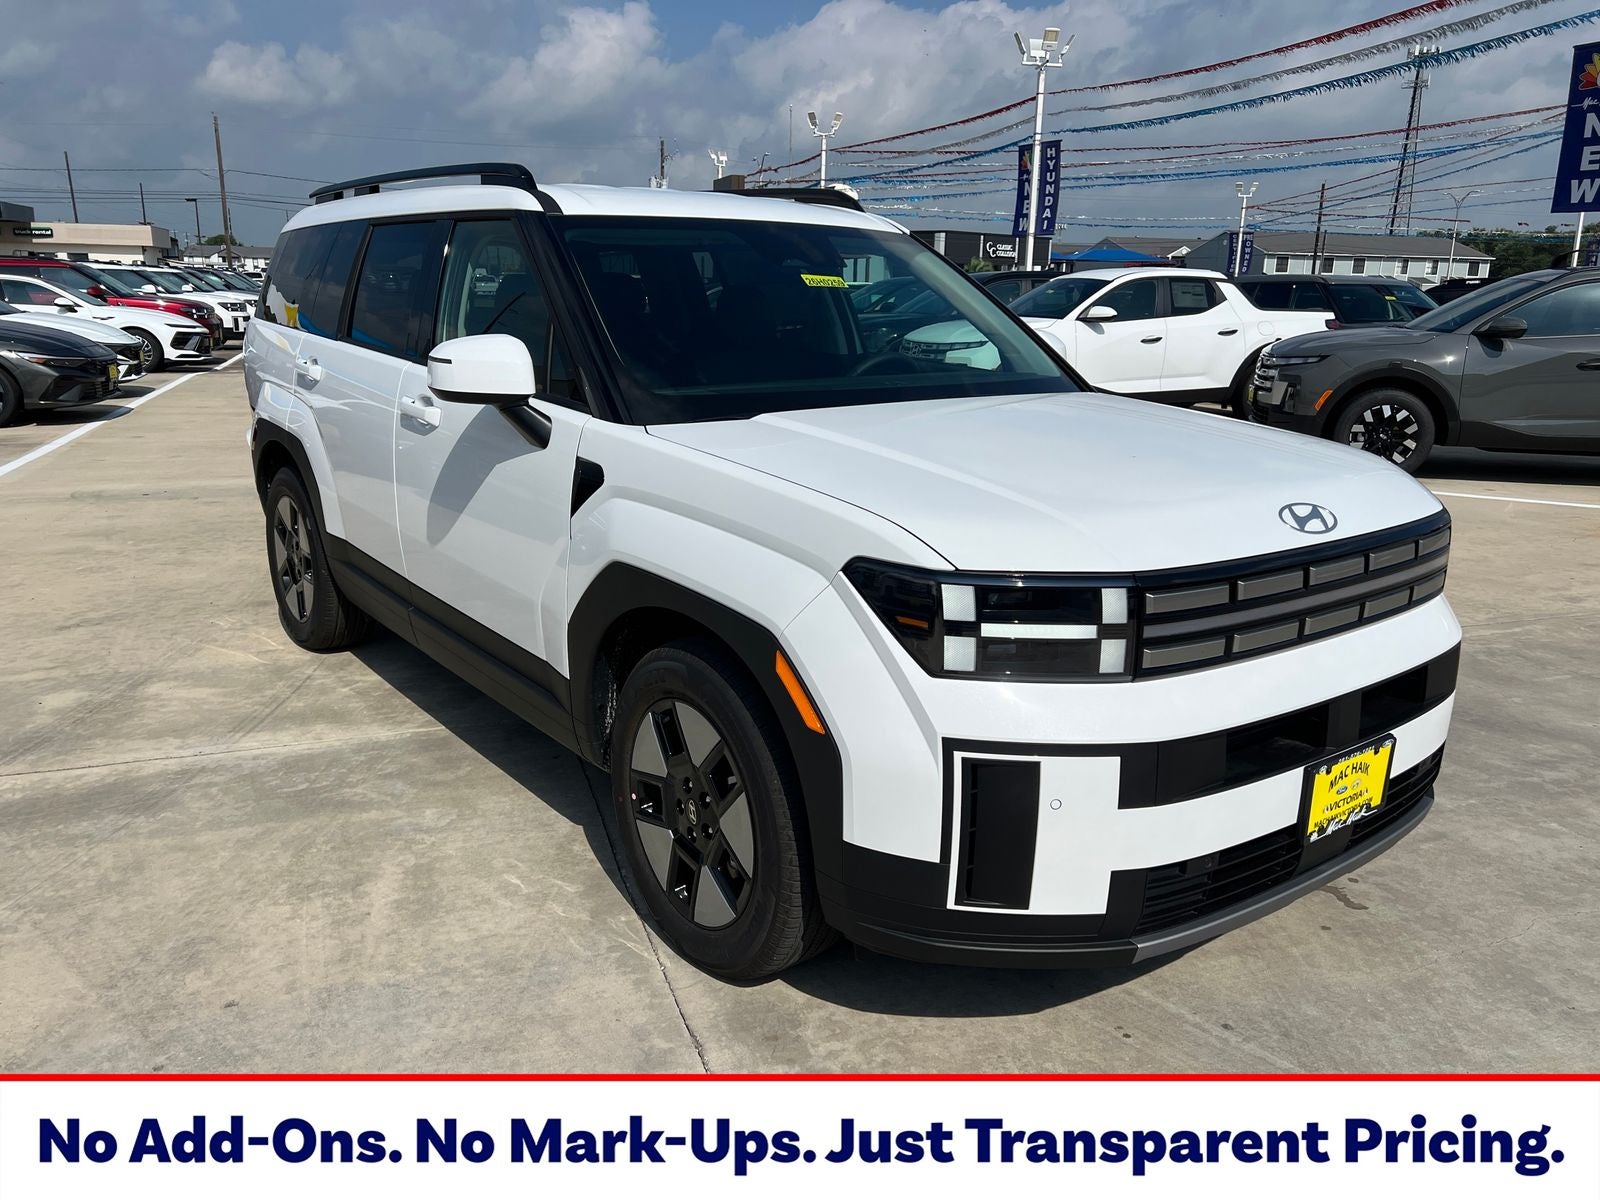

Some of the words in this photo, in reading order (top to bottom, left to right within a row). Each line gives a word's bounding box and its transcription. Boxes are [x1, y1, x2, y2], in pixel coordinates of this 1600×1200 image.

[1570, 112, 1600, 204] NEW
[1042, 147, 1056, 230] HYUNDAI
[1242, 241, 1251, 272] OWNED
[1327, 764, 1351, 793] MAC
[1350, 760, 1371, 777] HAIK
